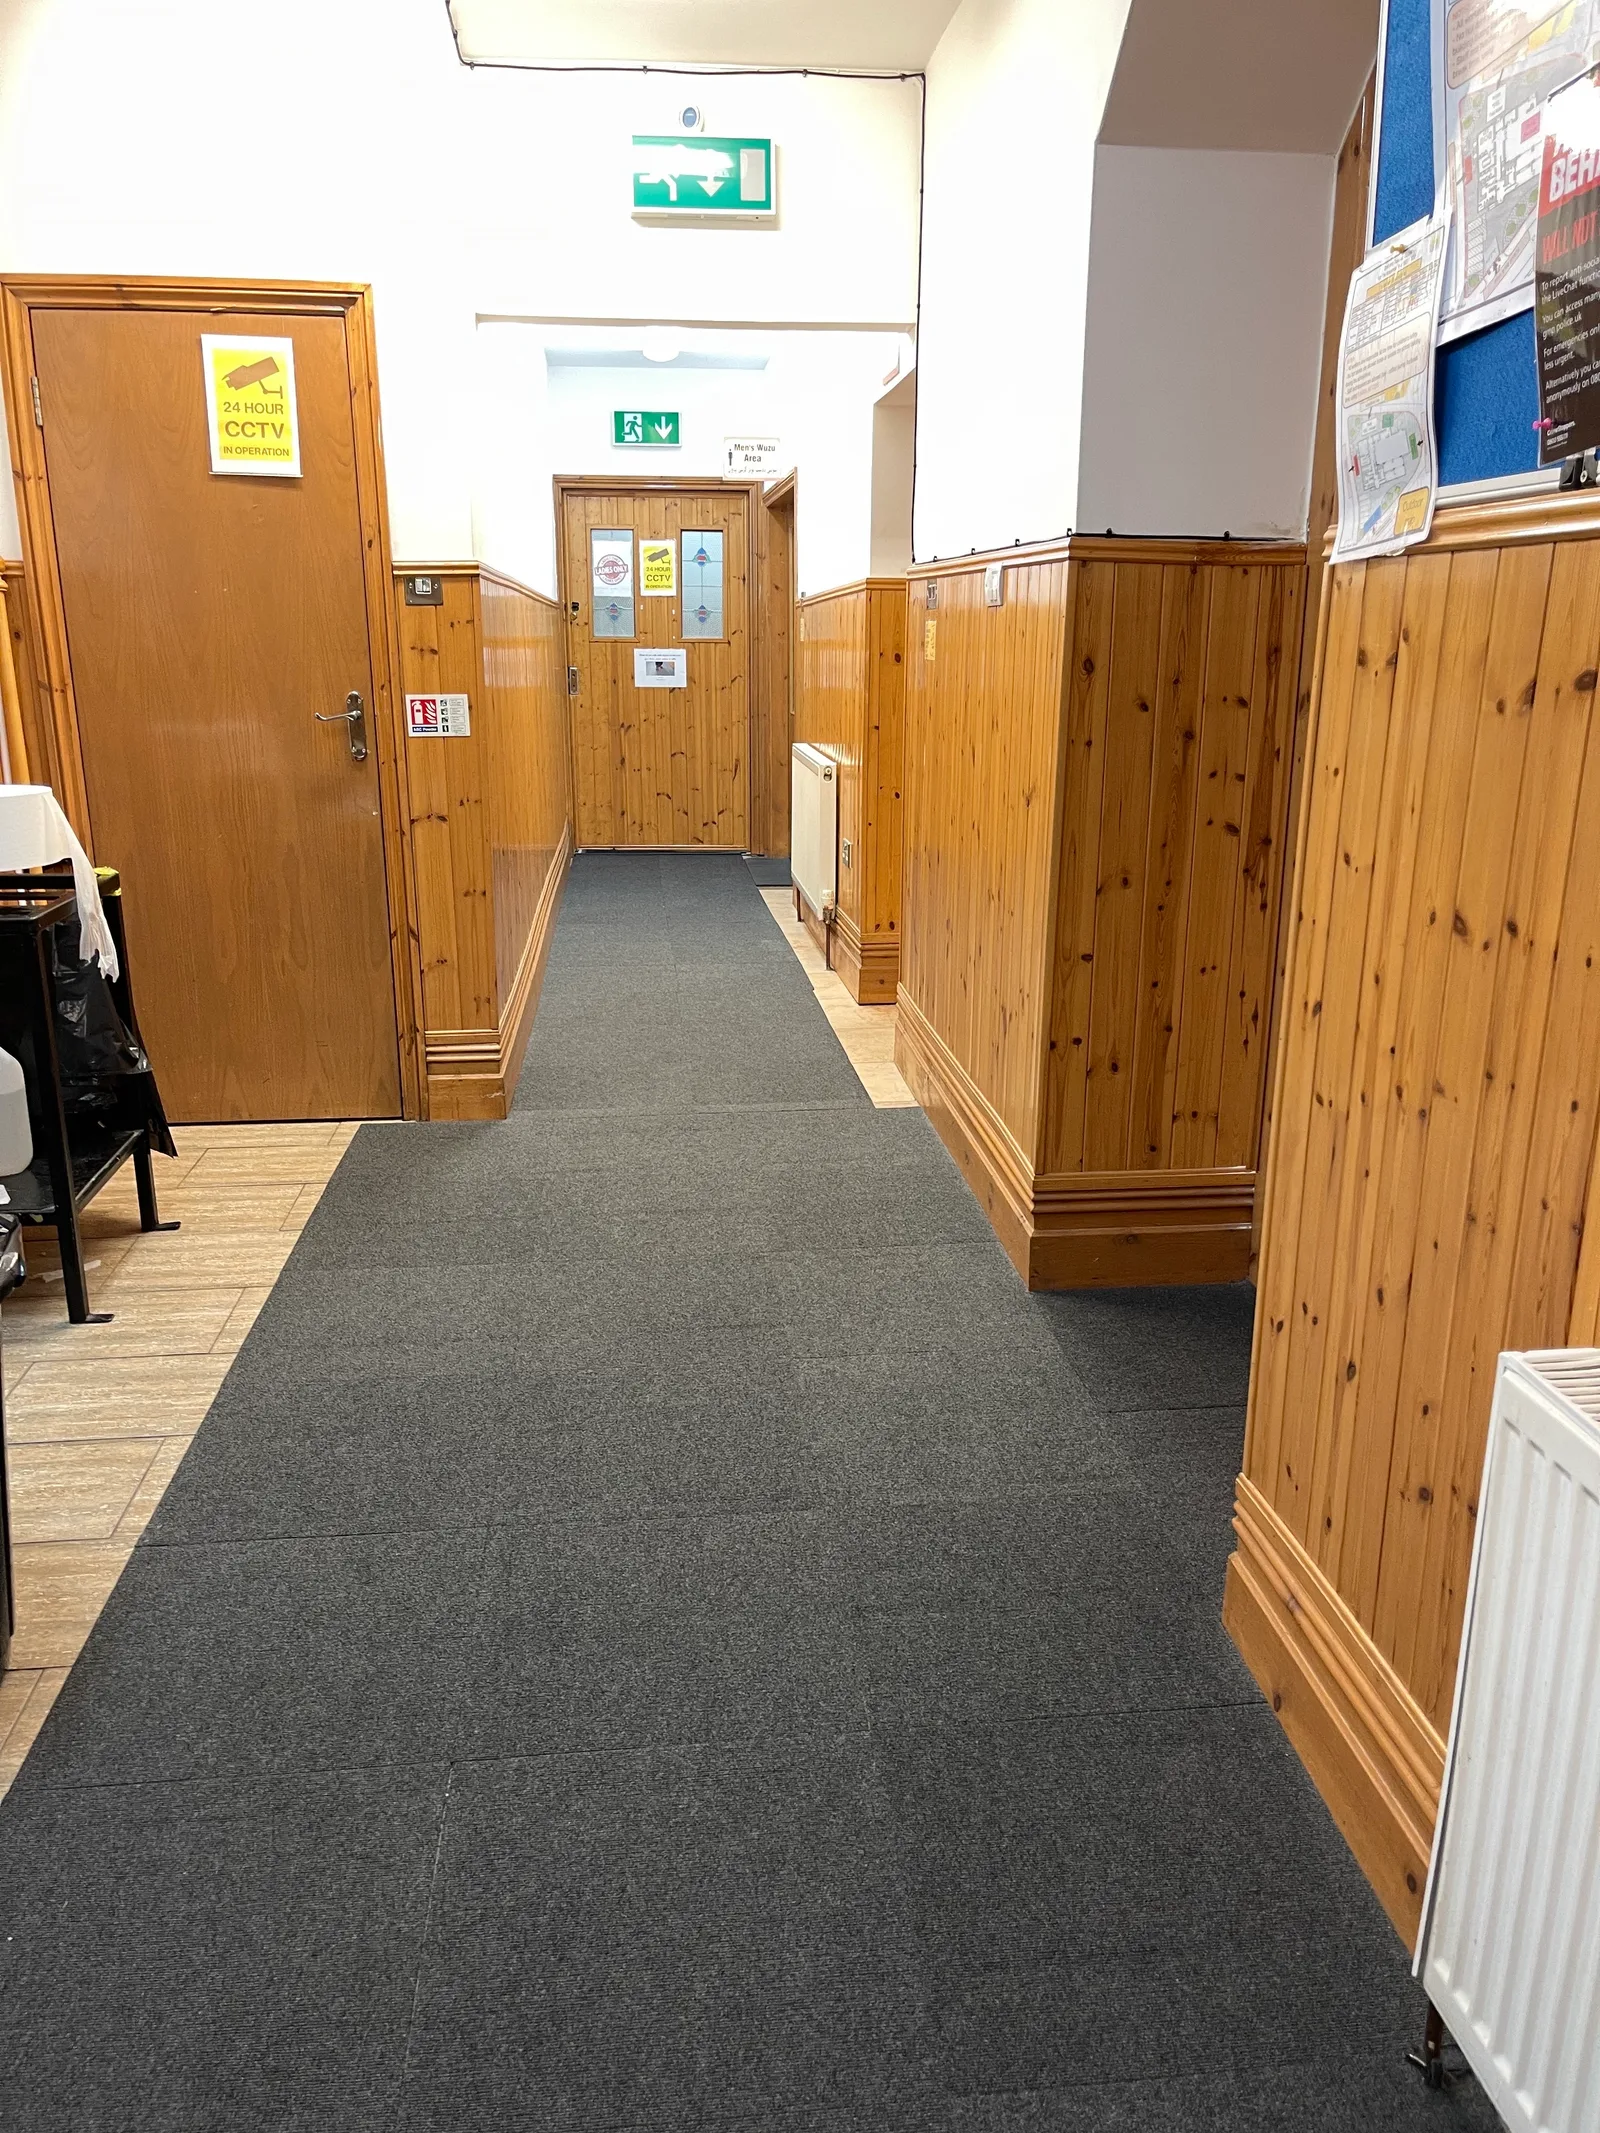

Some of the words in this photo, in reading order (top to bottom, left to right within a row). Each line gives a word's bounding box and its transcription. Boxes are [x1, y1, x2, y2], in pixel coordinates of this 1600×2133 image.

[1543, 226, 1569, 265] WILL
[1572, 210, 1598, 249] NOT
[1542, 281, 1548, 291] To
[1550, 270, 1569, 288] report
[1541, 294, 1551, 304] the
[1552, 280, 1578, 299] LiveChat
[1542, 314, 1553, 324] You
[1554, 308, 1564, 319] can
[1565, 298, 1583, 313] access
[1543, 347, 1553, 358] For
[1553, 331, 1589, 353] emergencies
[1544, 360, 1554, 371] less
[1554, 351, 1576, 366] urgent.
[1545, 368, 1580, 391] Alternatively
[1580, 364, 1591, 378] you
[1546, 381, 1581, 404] anonymously
[1581, 378, 1590, 388] on
[223, 401, 241, 413] 24
[244, 402, 284, 415] HOUR
[225, 420, 285, 439] CCTV
[223, 446, 233, 454] IN
[234, 446, 290, 457] OPERATION
[734, 443, 755, 452] Men's
[756, 443, 776, 452] Wuzu
[744, 453, 762, 463] Area
[646, 574, 671, 582] CCTV
